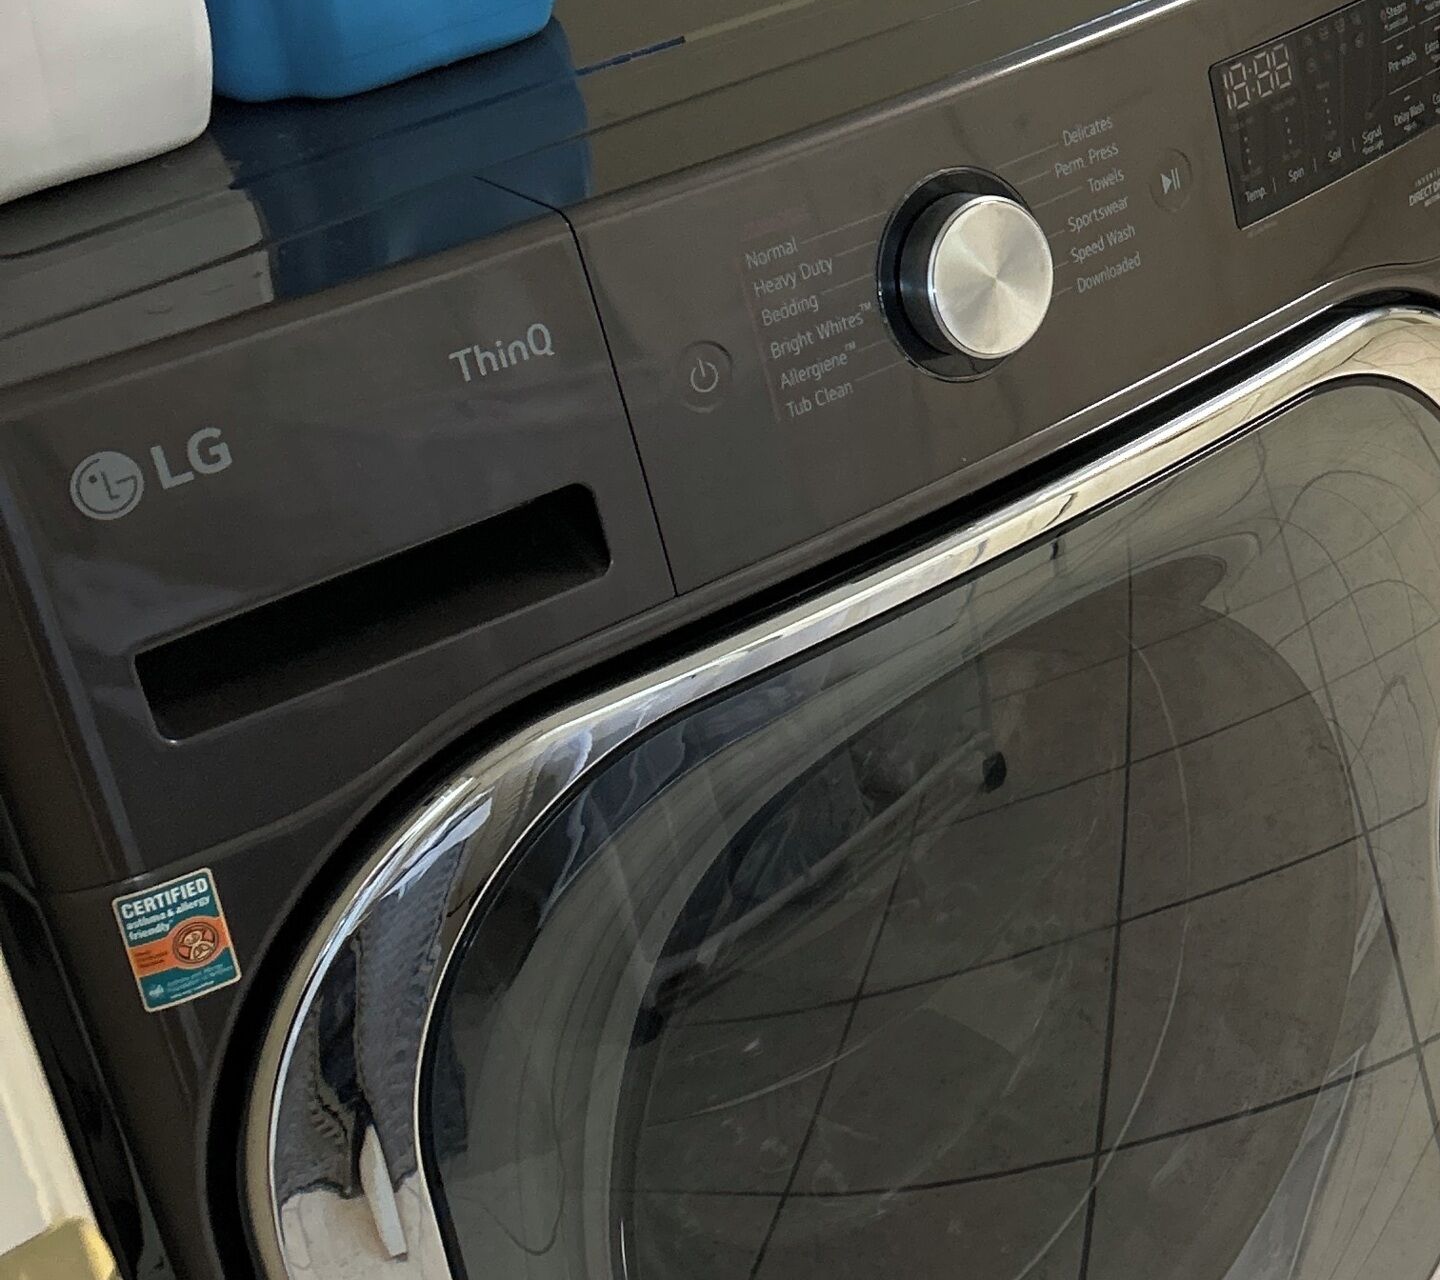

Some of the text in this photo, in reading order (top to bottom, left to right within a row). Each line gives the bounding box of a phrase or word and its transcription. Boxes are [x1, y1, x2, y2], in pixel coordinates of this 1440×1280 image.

[1062, 116, 1113, 146] Delicates
[1088, 142, 1119, 165] Press
[1327, 145, 1342, 163] Soil
[1087, 168, 1126, 193] Towels
[1288, 165, 1305, 183] Spin
[1068, 196, 1129, 233] Sportswear
[745, 237, 798, 269] Normal
[1070, 223, 1136, 264] Speed Wash
[754, 257, 833, 299] Heavy Duty
[1076, 251, 1142, 293] Downloaded
[761, 293, 819, 327] Bedding
[449, 322, 556, 383] ThinQ
[770, 332, 814, 359] Bright
[786, 381, 854, 418] Tub Clean
[150, 426, 233, 490] LG
[121, 877, 209, 920] CERTIFIED
